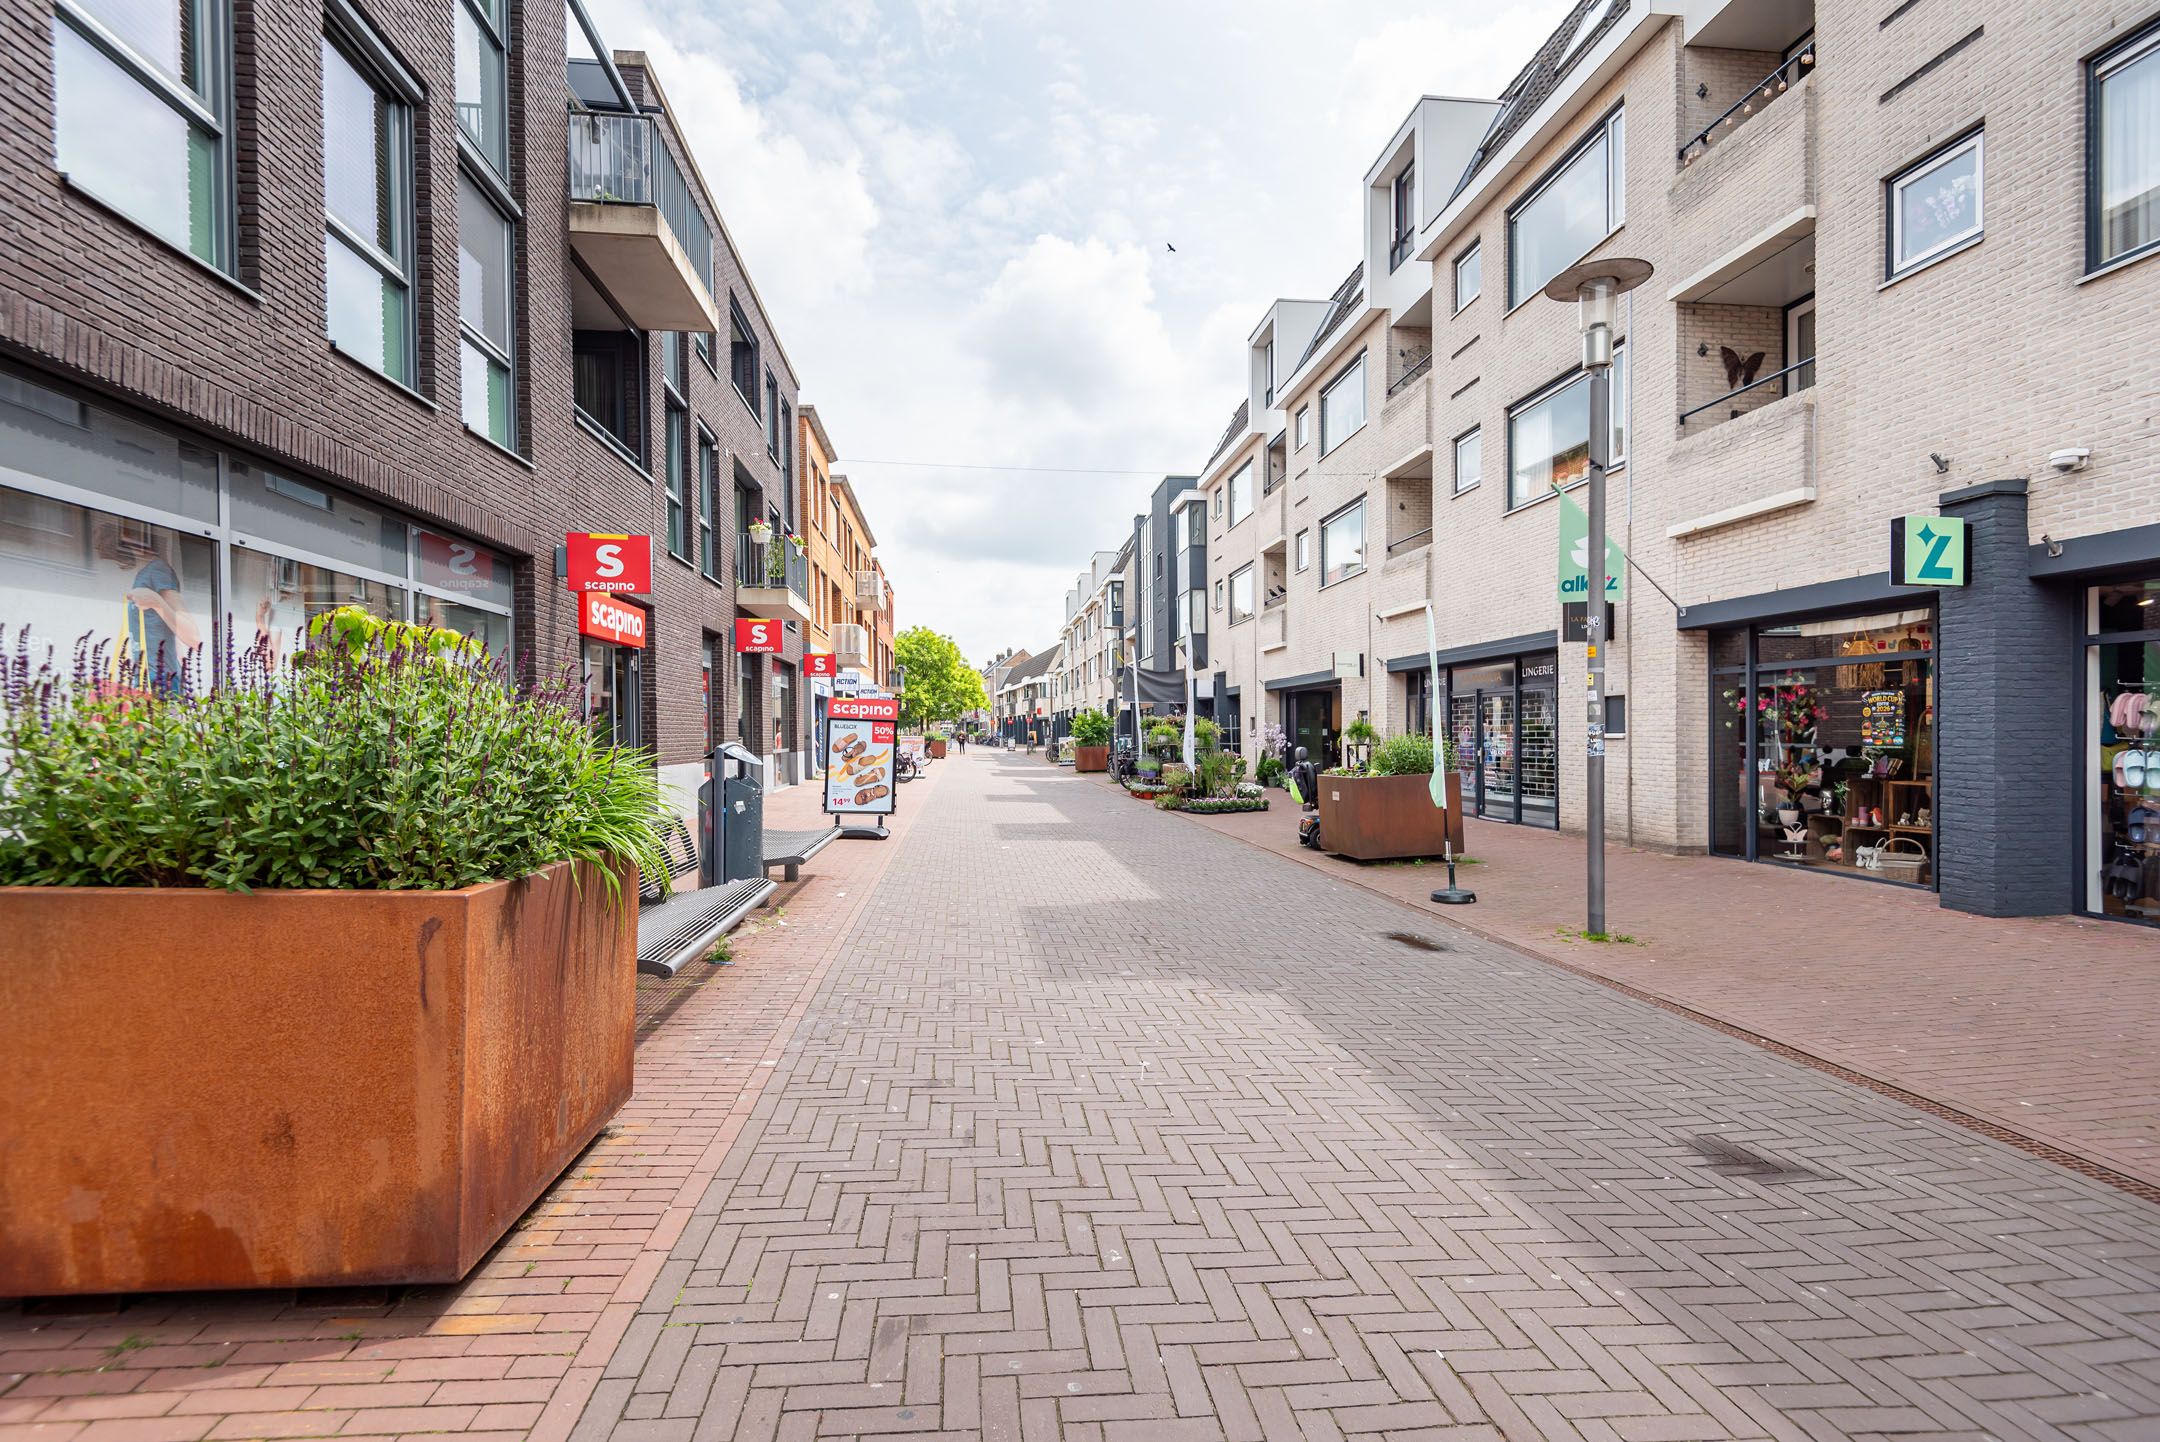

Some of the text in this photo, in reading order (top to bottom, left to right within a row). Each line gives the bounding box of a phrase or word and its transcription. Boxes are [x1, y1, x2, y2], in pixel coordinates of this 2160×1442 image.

[595, 544, 625, 577] S
[585, 581, 635, 592] scapino
[1561, 575, 1617, 593] alkz
[591, 601, 642, 641] scapino
[751, 624, 768, 644] S
[814, 657, 826, 672] S
[1522, 664, 1554, 678] LINGERIE
[1868, 696, 1887, 704] WORLD
[832, 703, 893, 719] scapino
[873, 727, 894, 735] 50%
